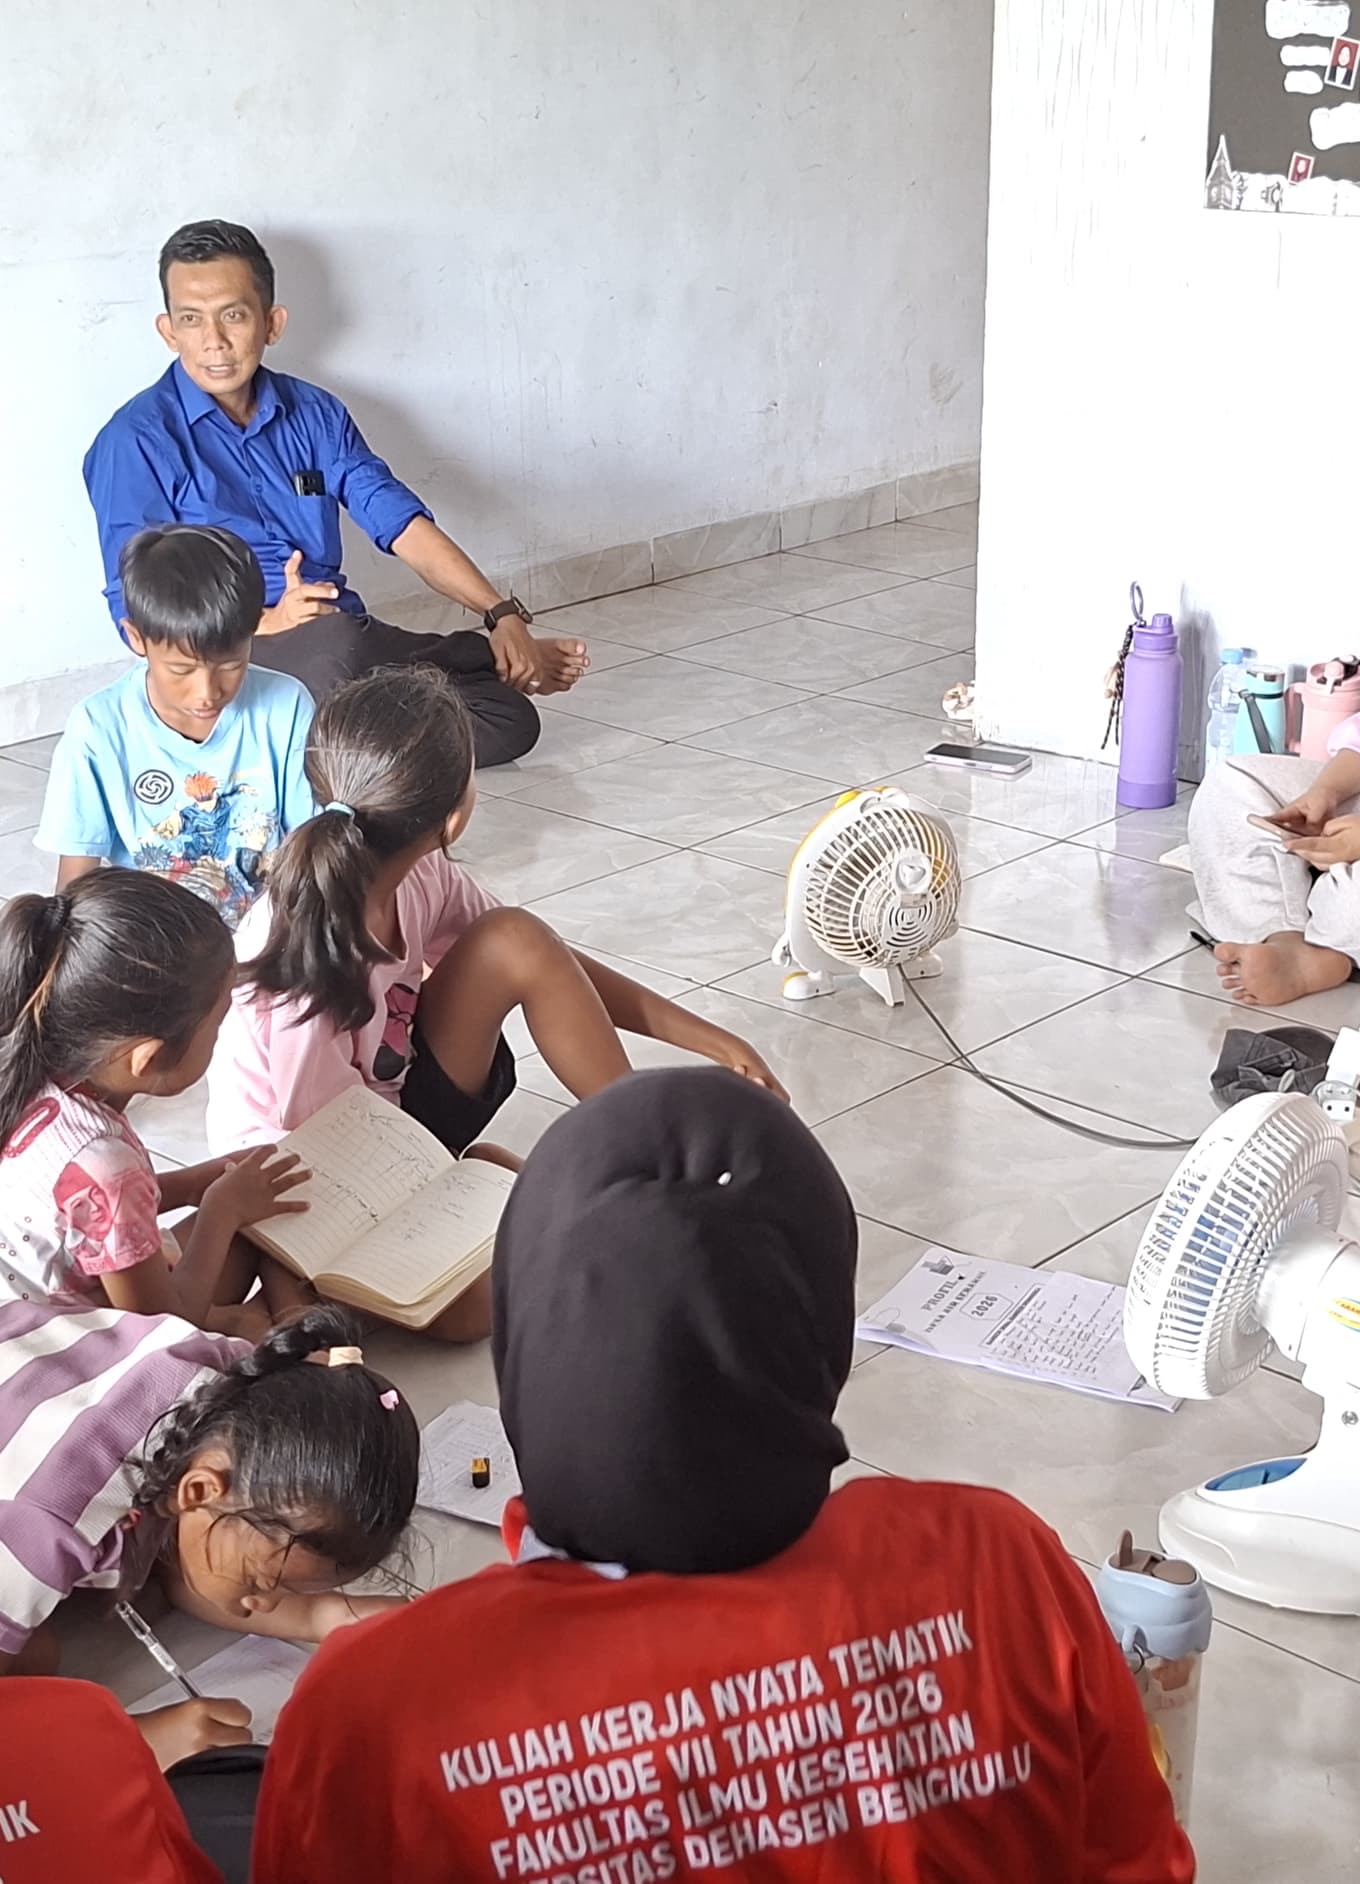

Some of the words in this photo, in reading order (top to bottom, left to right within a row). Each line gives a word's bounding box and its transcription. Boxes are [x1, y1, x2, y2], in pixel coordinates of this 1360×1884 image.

[971, 1295, 999, 1318] 2026
[439, 1719, 574, 1792] KULIAH
[579, 1686, 706, 1757] KERJA
[711, 1654, 824, 1722] NYATA
[828, 1609, 973, 1689] TEMATIK
[499, 1750, 661, 1829] PERIODE
[665, 1733, 718, 1783] VII
[722, 1698, 844, 1768] TAHUN
[851, 1670, 943, 1735] 2026
[490, 1798, 671, 1880] FAKULTAS
[677, 1770, 768, 1831] ILMU
[775, 1709, 975, 1803] KESEHATAN
[683, 1792, 849, 1869] DEHASEN
[856, 1741, 1032, 1827] BENGKULU
